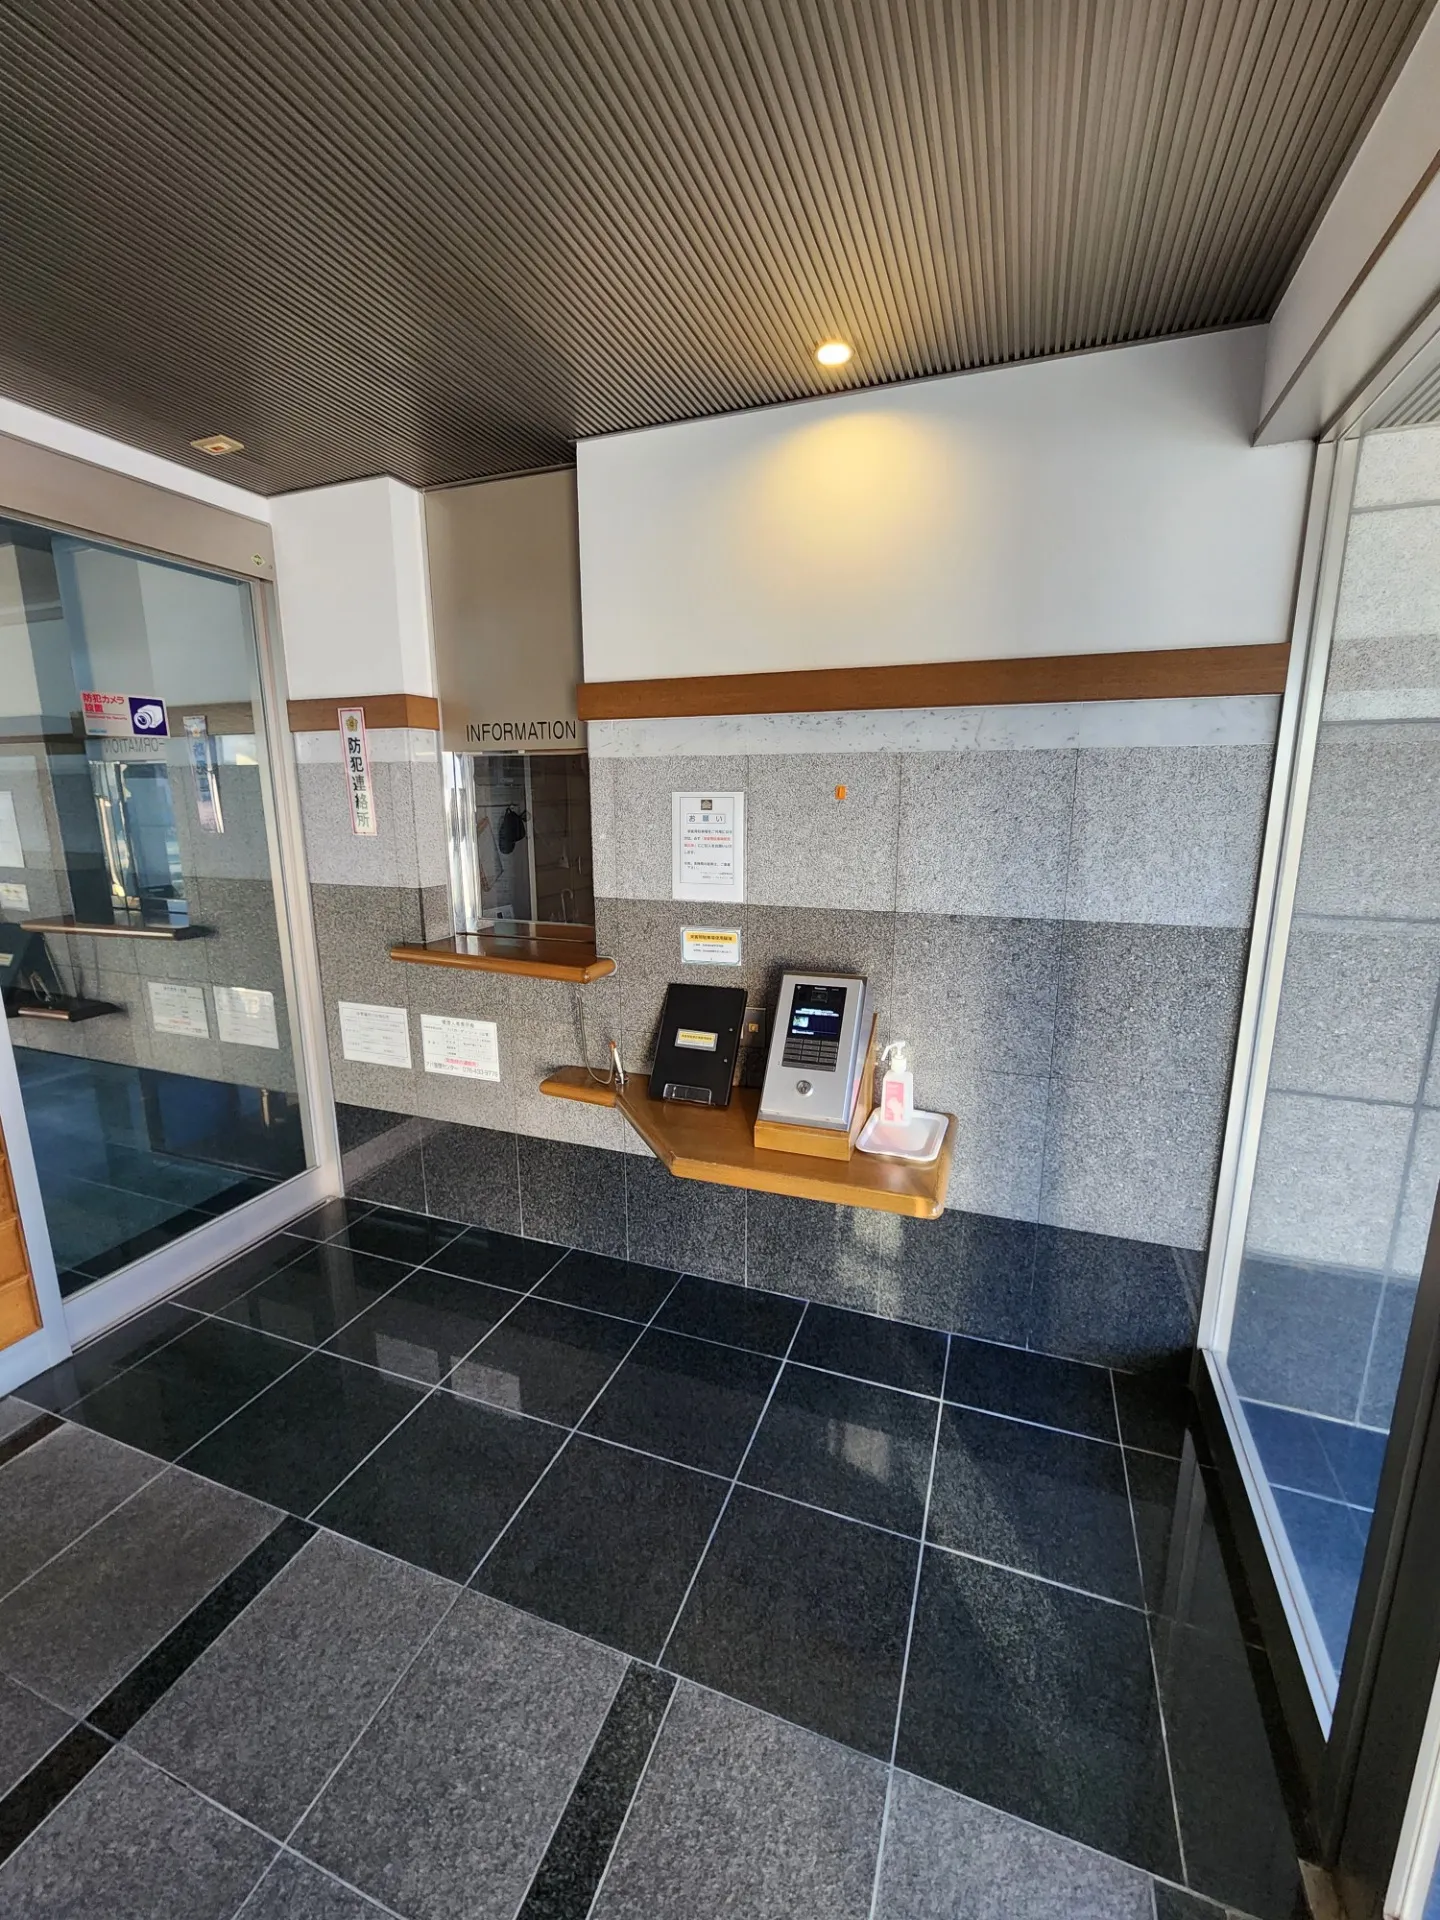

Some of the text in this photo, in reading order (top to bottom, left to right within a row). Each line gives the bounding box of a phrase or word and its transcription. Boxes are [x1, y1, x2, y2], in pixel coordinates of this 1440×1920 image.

[82, 693, 125, 705] 防犯カメラ
[466, 720, 576, 742] INFORMATION
[347, 737, 370, 828] 防犯連絡所
